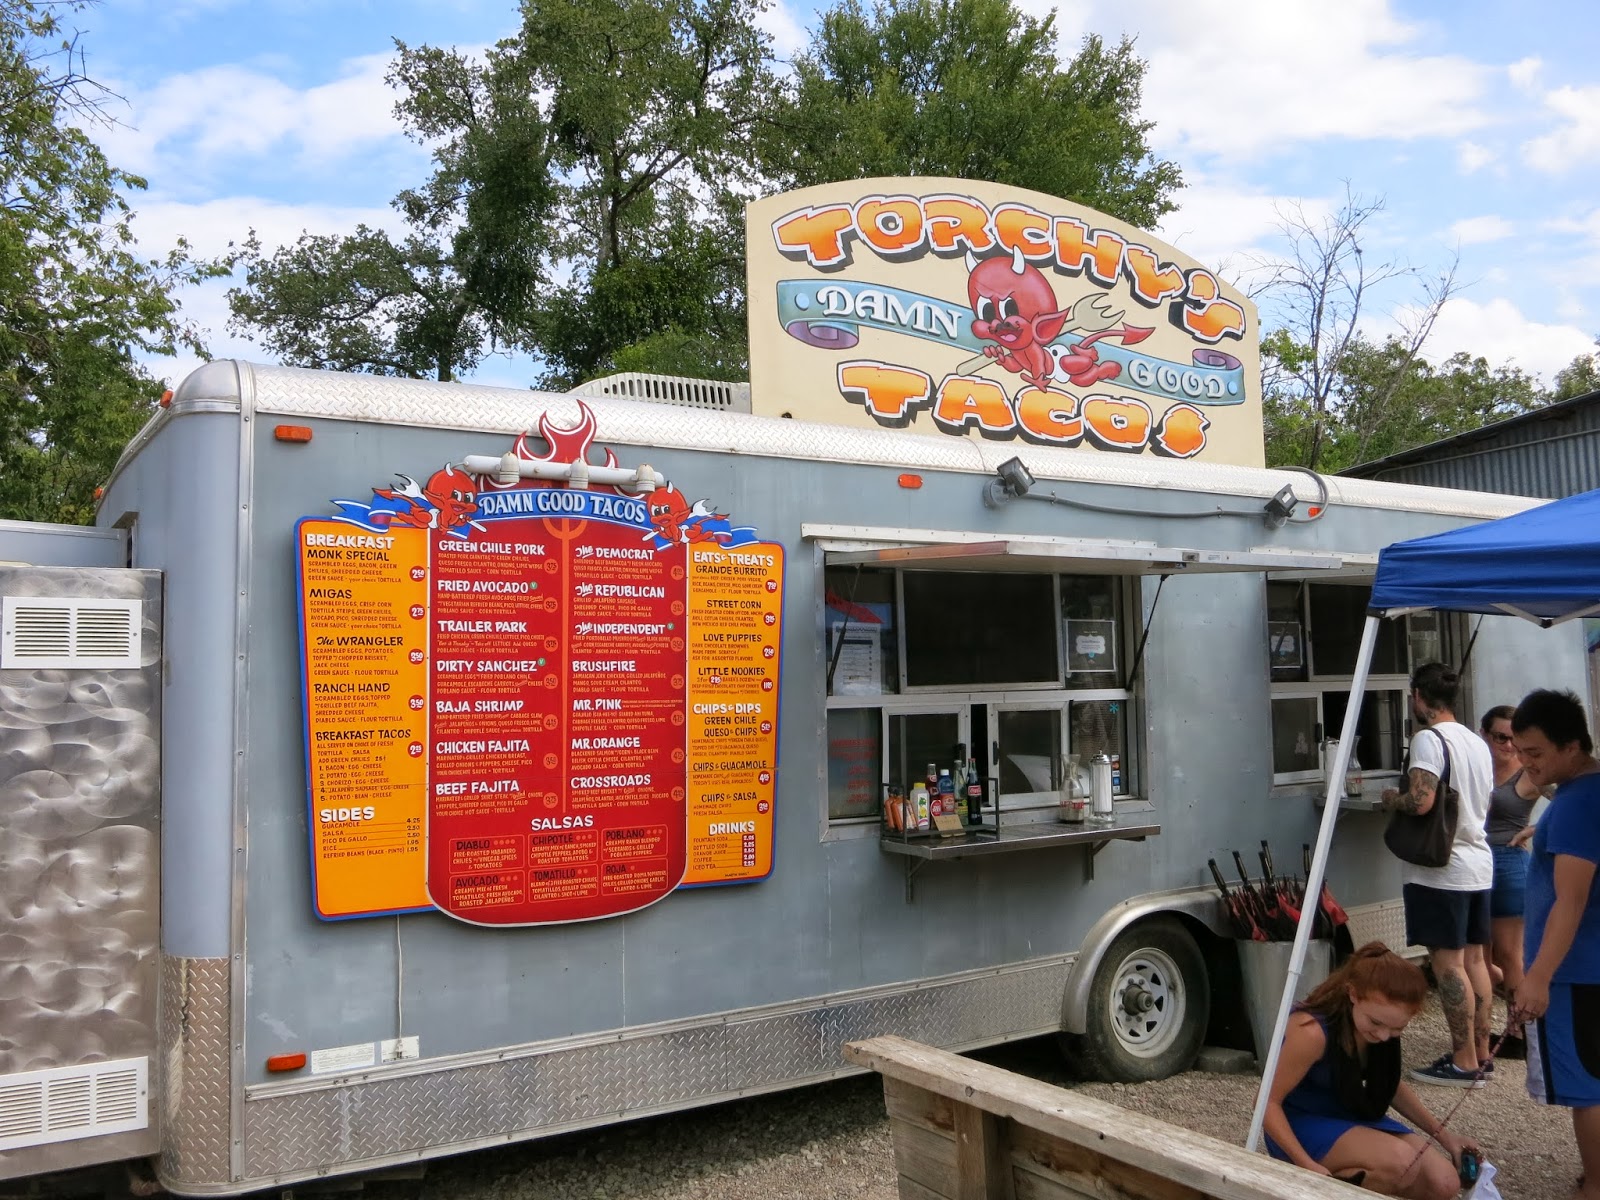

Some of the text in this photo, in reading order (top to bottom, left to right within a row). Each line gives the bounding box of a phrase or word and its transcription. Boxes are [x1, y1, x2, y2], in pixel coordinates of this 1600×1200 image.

[771, 193, 1247, 344] TORCHY'S
[815, 286, 1227, 399] DAMN GOOD
[836, 358, 1211, 460] TACOS
[479, 492, 645, 523] DAMN GOOD TACOS
[306, 534, 394, 549] BREAKFAST
[439, 540, 545, 555] GREEN CHILE PORK
[575, 545, 654, 560] The DEMOCRAT
[307, 550, 389, 561] MONK SPECIAL
[693, 552, 720, 563] EATS
[728, 553, 773, 566] TREATS
[696, 565, 767, 576] GRANDE BURRITO
[438, 580, 470, 591] FRIED
[473, 581, 528, 593] AVOCADO
[575, 582, 664, 598] The REPUBLICAN
[310, 589, 352, 599] MIGAS
[707, 600, 761, 609] STREET CORN
[438, 621, 527, 633] TRAILER PARK
[575, 622, 593, 635] The
[594, 624, 665, 634] INDEPENDENT
[317, 637, 403, 646] The WRANGLER
[727, 634, 762, 642] PUPPIES
[437, 661, 473, 671] DIRTY
[477, 661, 537, 671] SANCHEZ
[572, 661, 636, 671] BRUSHFIRE
[699, 667, 765, 675] LITTLE NOOKIES
[314, 683, 390, 693] RANCH HAND
[436, 700, 523, 713] BAJA SHRIMP
[693, 704, 727, 714] CHIPS
[735, 704, 761, 714] DIPS
[705, 716, 756, 725] GREEN CHILE
[316, 729, 411, 740] BREAKFAST TACOS
[704, 728, 729, 737] QUESO
[735, 727, 757, 736] CHIPS
[436, 740, 530, 753] CHICKEN FAJITA
[693, 762, 714, 771] CHIPS
[721, 761, 767, 770] GUACAMOLE
[571, 774, 651, 788] CROSSROADS
[436, 780, 519, 795] BEEF FAJITA
[702, 793, 725, 802] CHIPS
[733, 792, 757, 801] SALSA
[320, 806, 375, 823] SIDES
[531, 815, 594, 831] SALSAS
[709, 821, 755, 836] DRINKS
[606, 829, 644, 839] POBLANO
[456, 840, 490, 850] DIABLO
[534, 869, 575, 880] TOMATILLO
[606, 865, 626, 874] ROJA
[455, 875, 498, 887] AVOCADO
